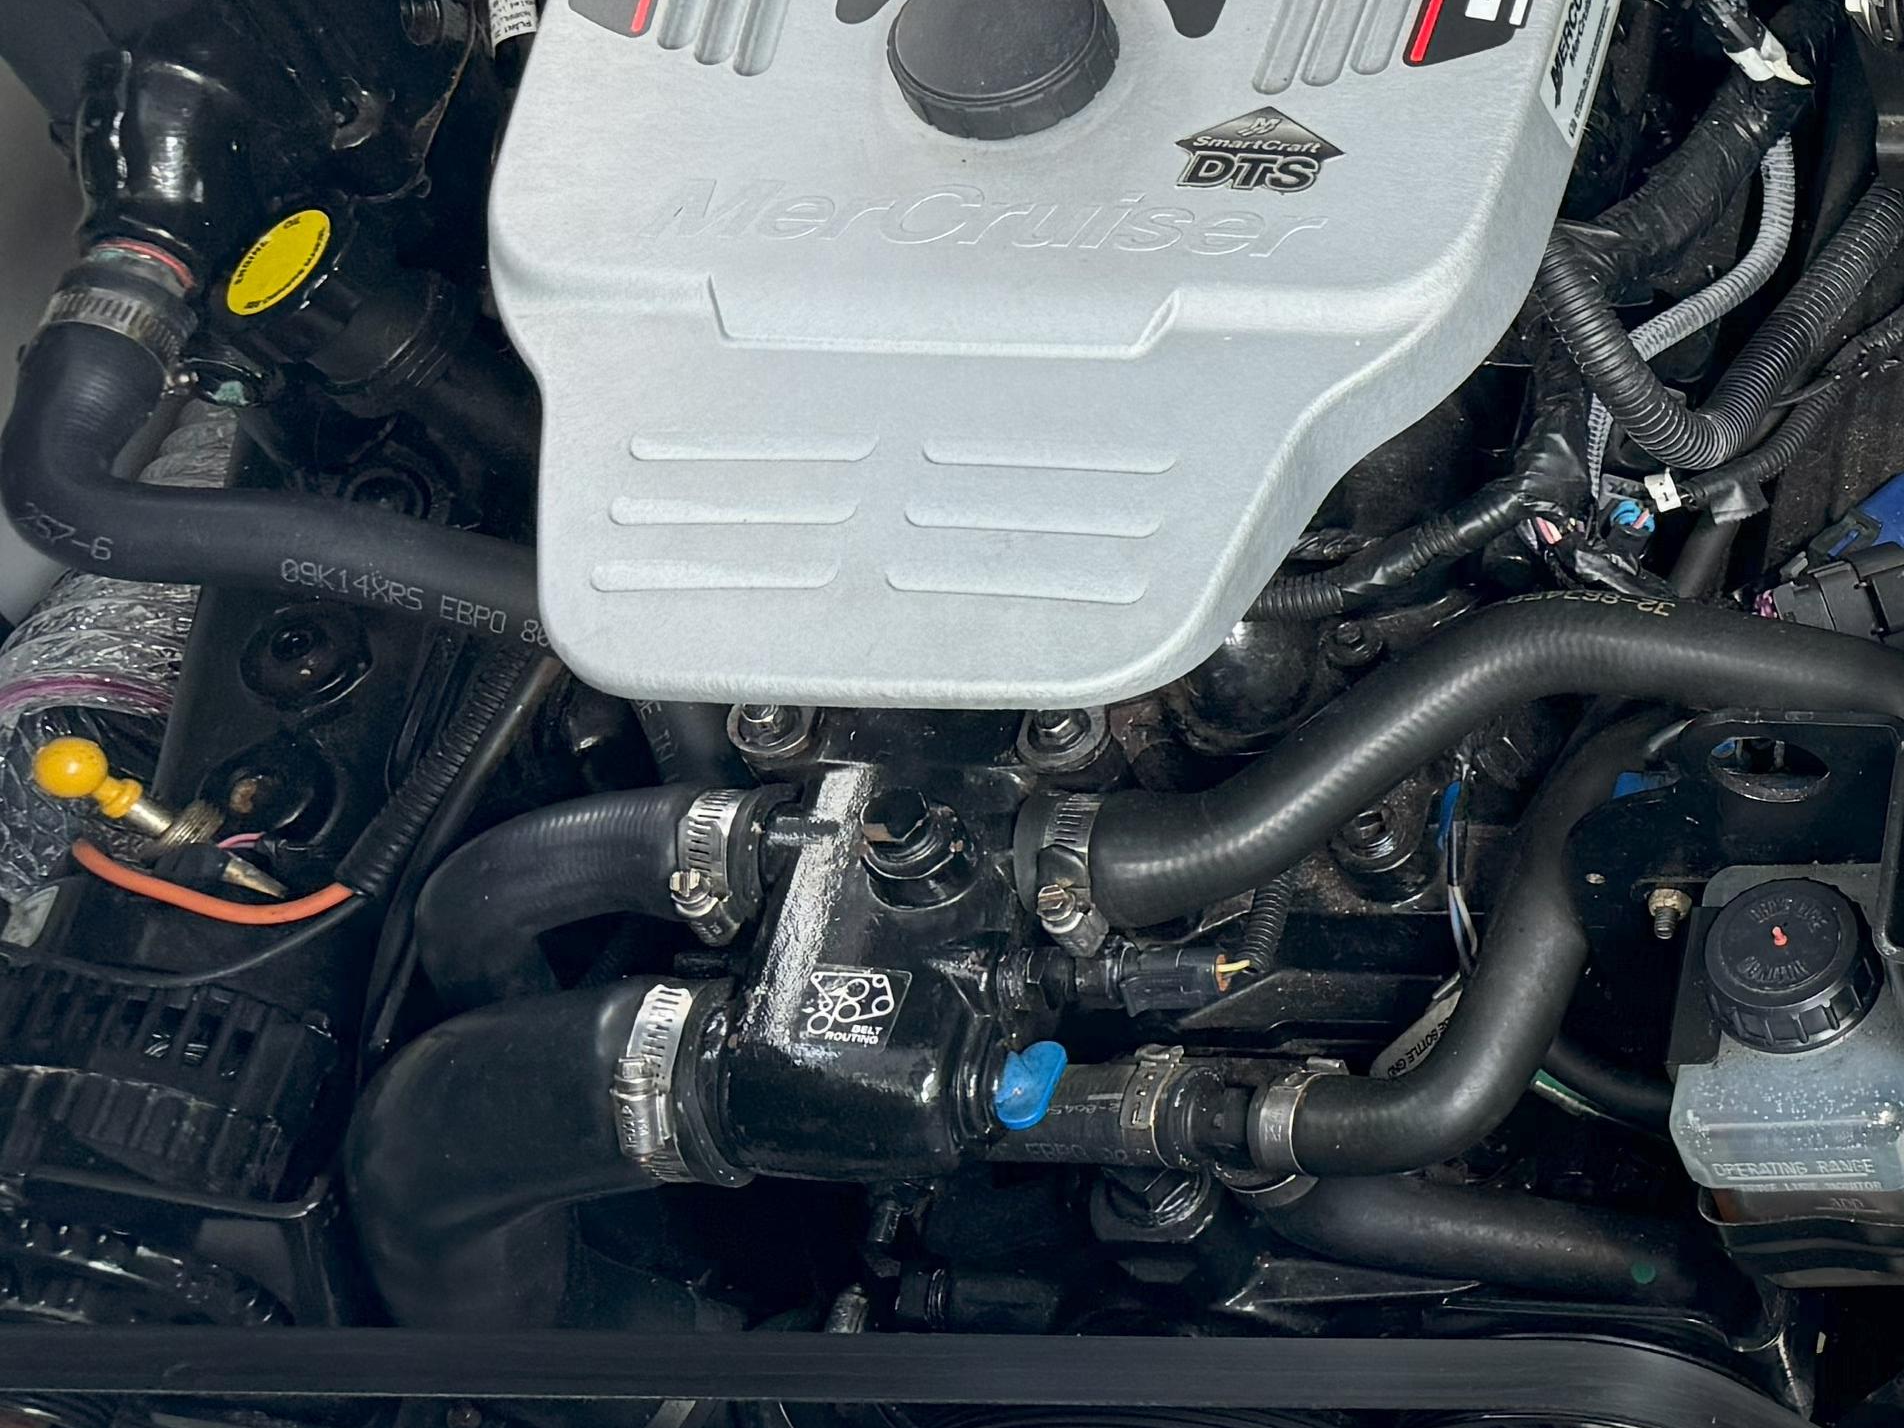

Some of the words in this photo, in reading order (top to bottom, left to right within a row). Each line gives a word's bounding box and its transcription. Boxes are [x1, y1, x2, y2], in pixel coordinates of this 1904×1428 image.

[1192, 135, 1321, 154] SmartCraft
[1174, 151, 1322, 193] DTS
[646, 176, 1328, 258] MerCruiser
[824, 1031, 880, 1045] ROUTING
[851, 1024, 883, 1035] BELT
[1711, 1162, 1808, 1178] OPERATING
[1815, 1158, 1876, 1174] RANGE
